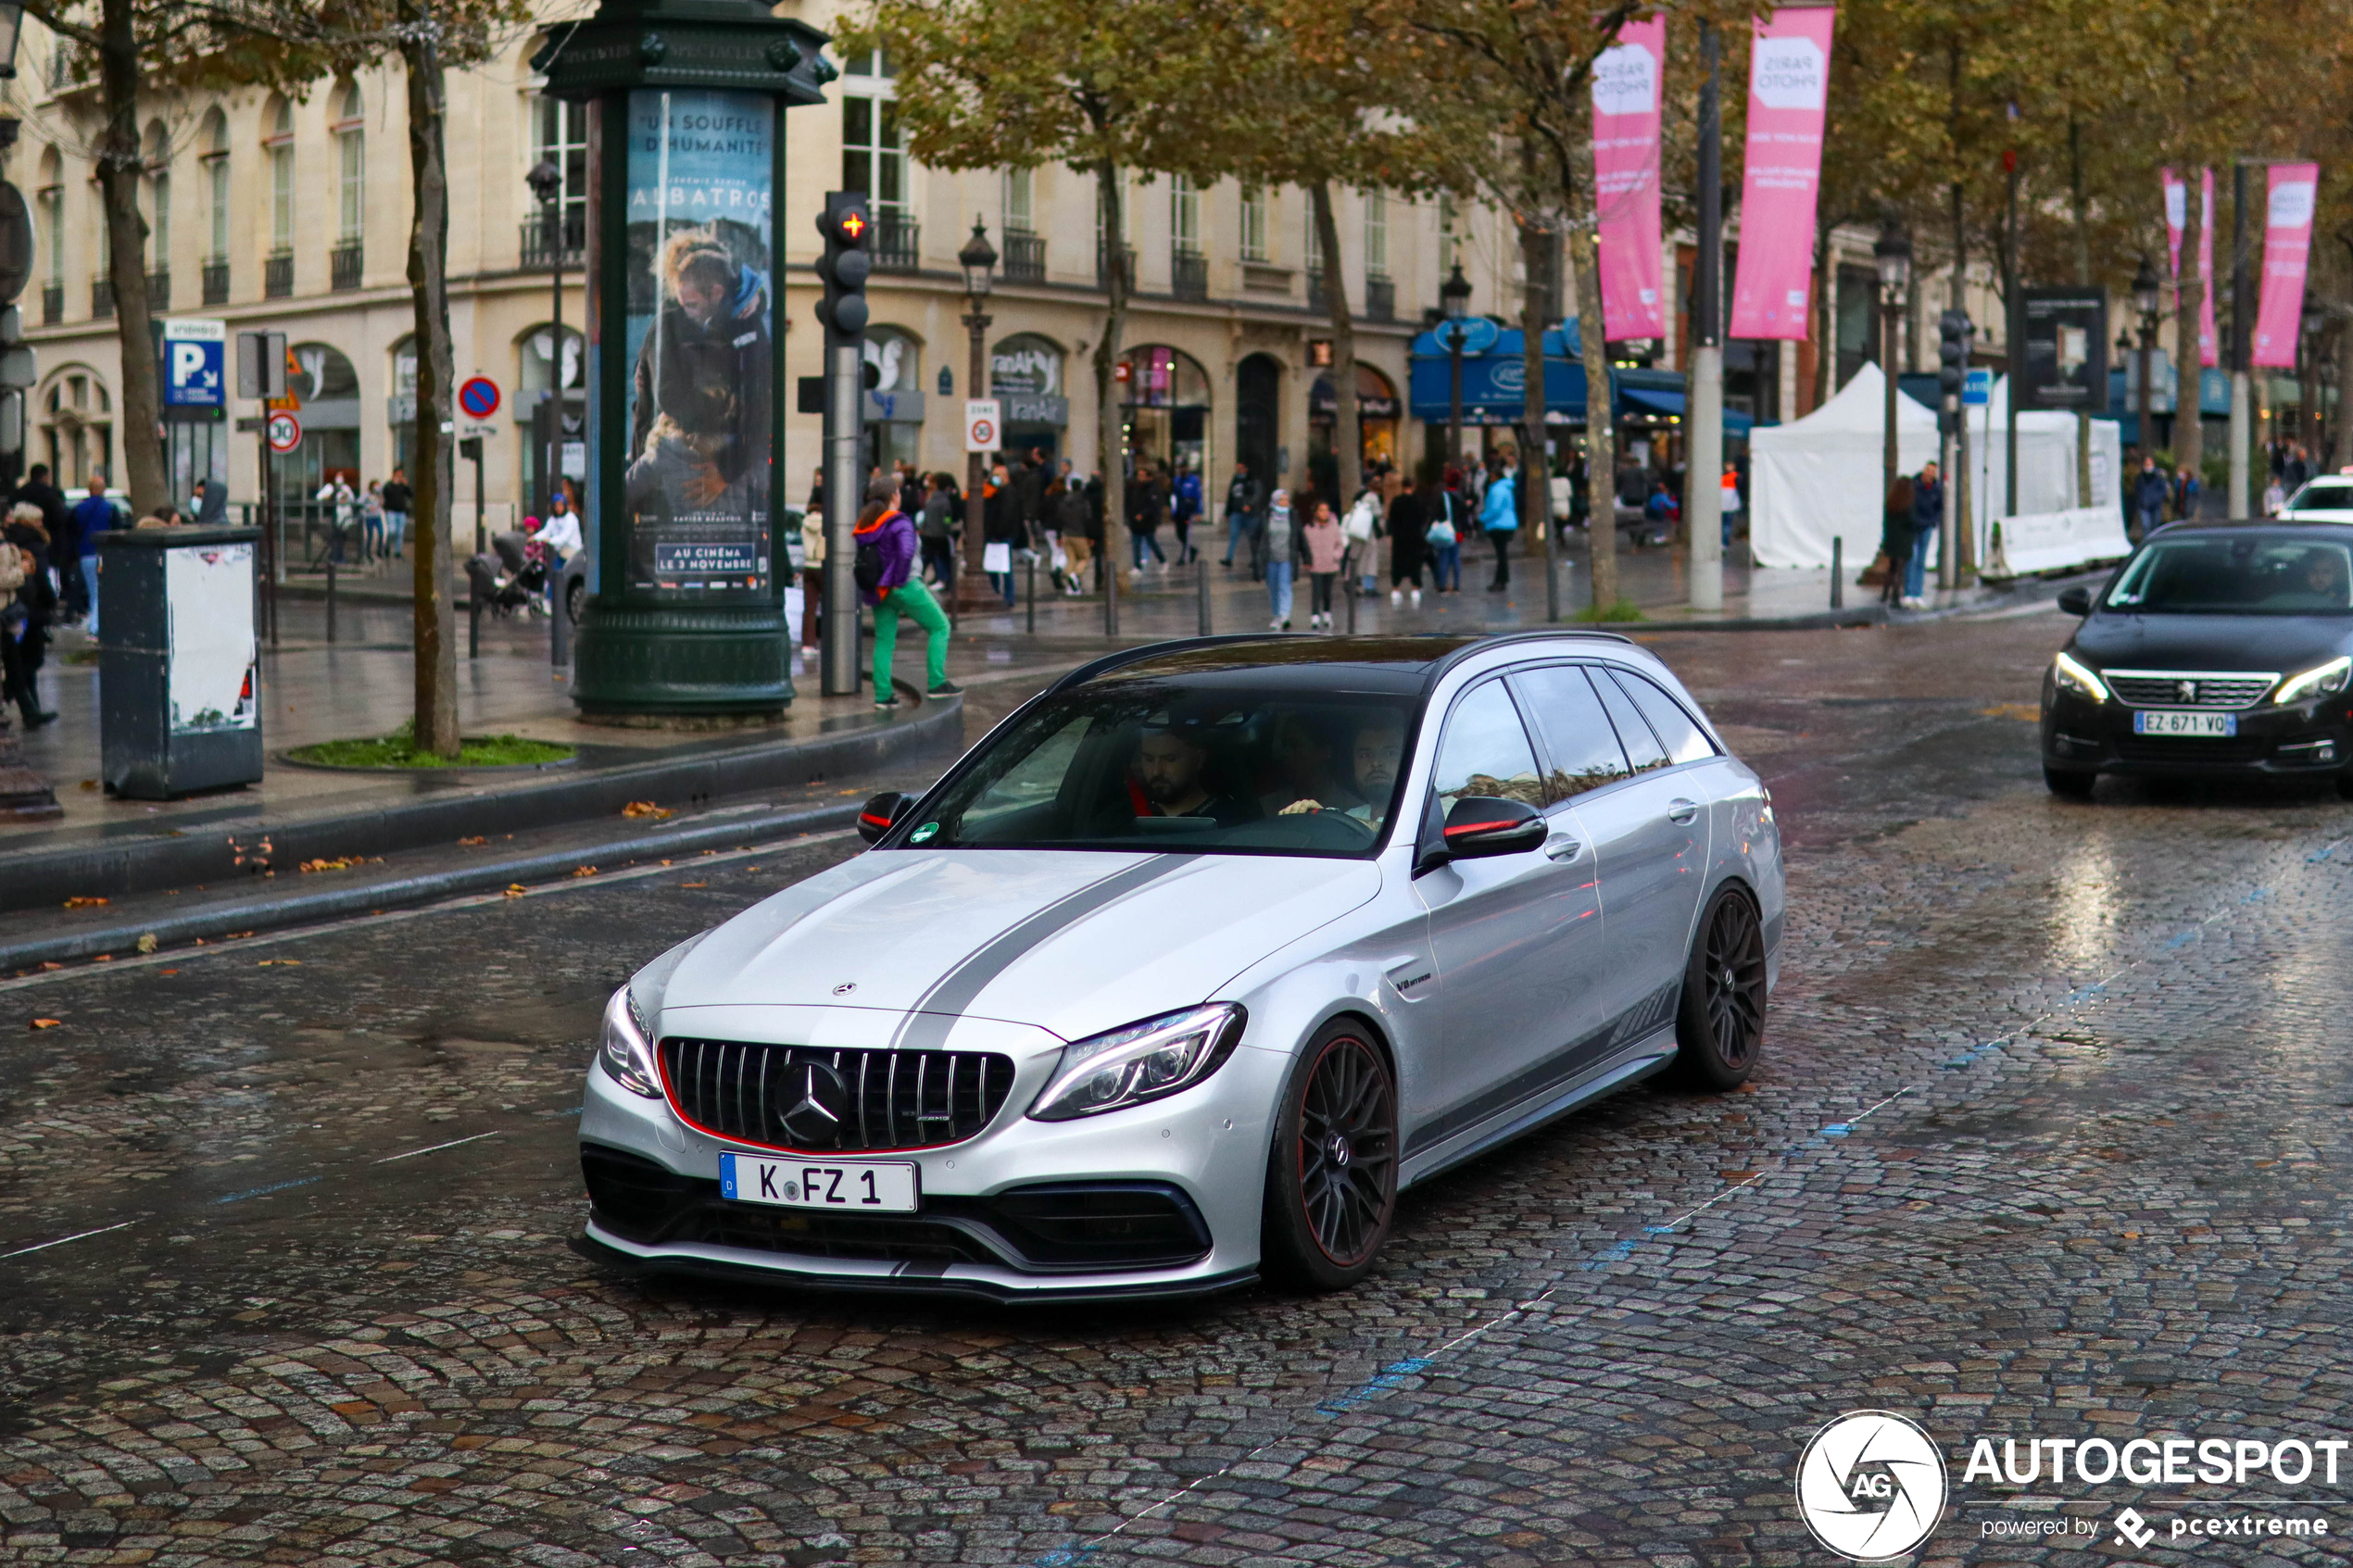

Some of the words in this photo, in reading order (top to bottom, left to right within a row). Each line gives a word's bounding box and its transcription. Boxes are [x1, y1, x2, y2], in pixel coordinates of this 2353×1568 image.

[633, 187, 772, 210] ALBATROS
[173, 343, 206, 387] P
[271, 422, 294, 440] 30
[975, 426, 990, 437] 30
[674, 548, 691, 558] AU
[696, 546, 741, 558] CINÉMA
[660, 559, 674, 570] LE
[678, 559, 686, 570] 3
[690, 558, 752, 570] NOVEMBRE
[725, 1180, 734, 1191] D
[760, 1163, 779, 1199] K
[802, 1168, 847, 1203] FZ
[861, 1170, 881, 1205] 1
